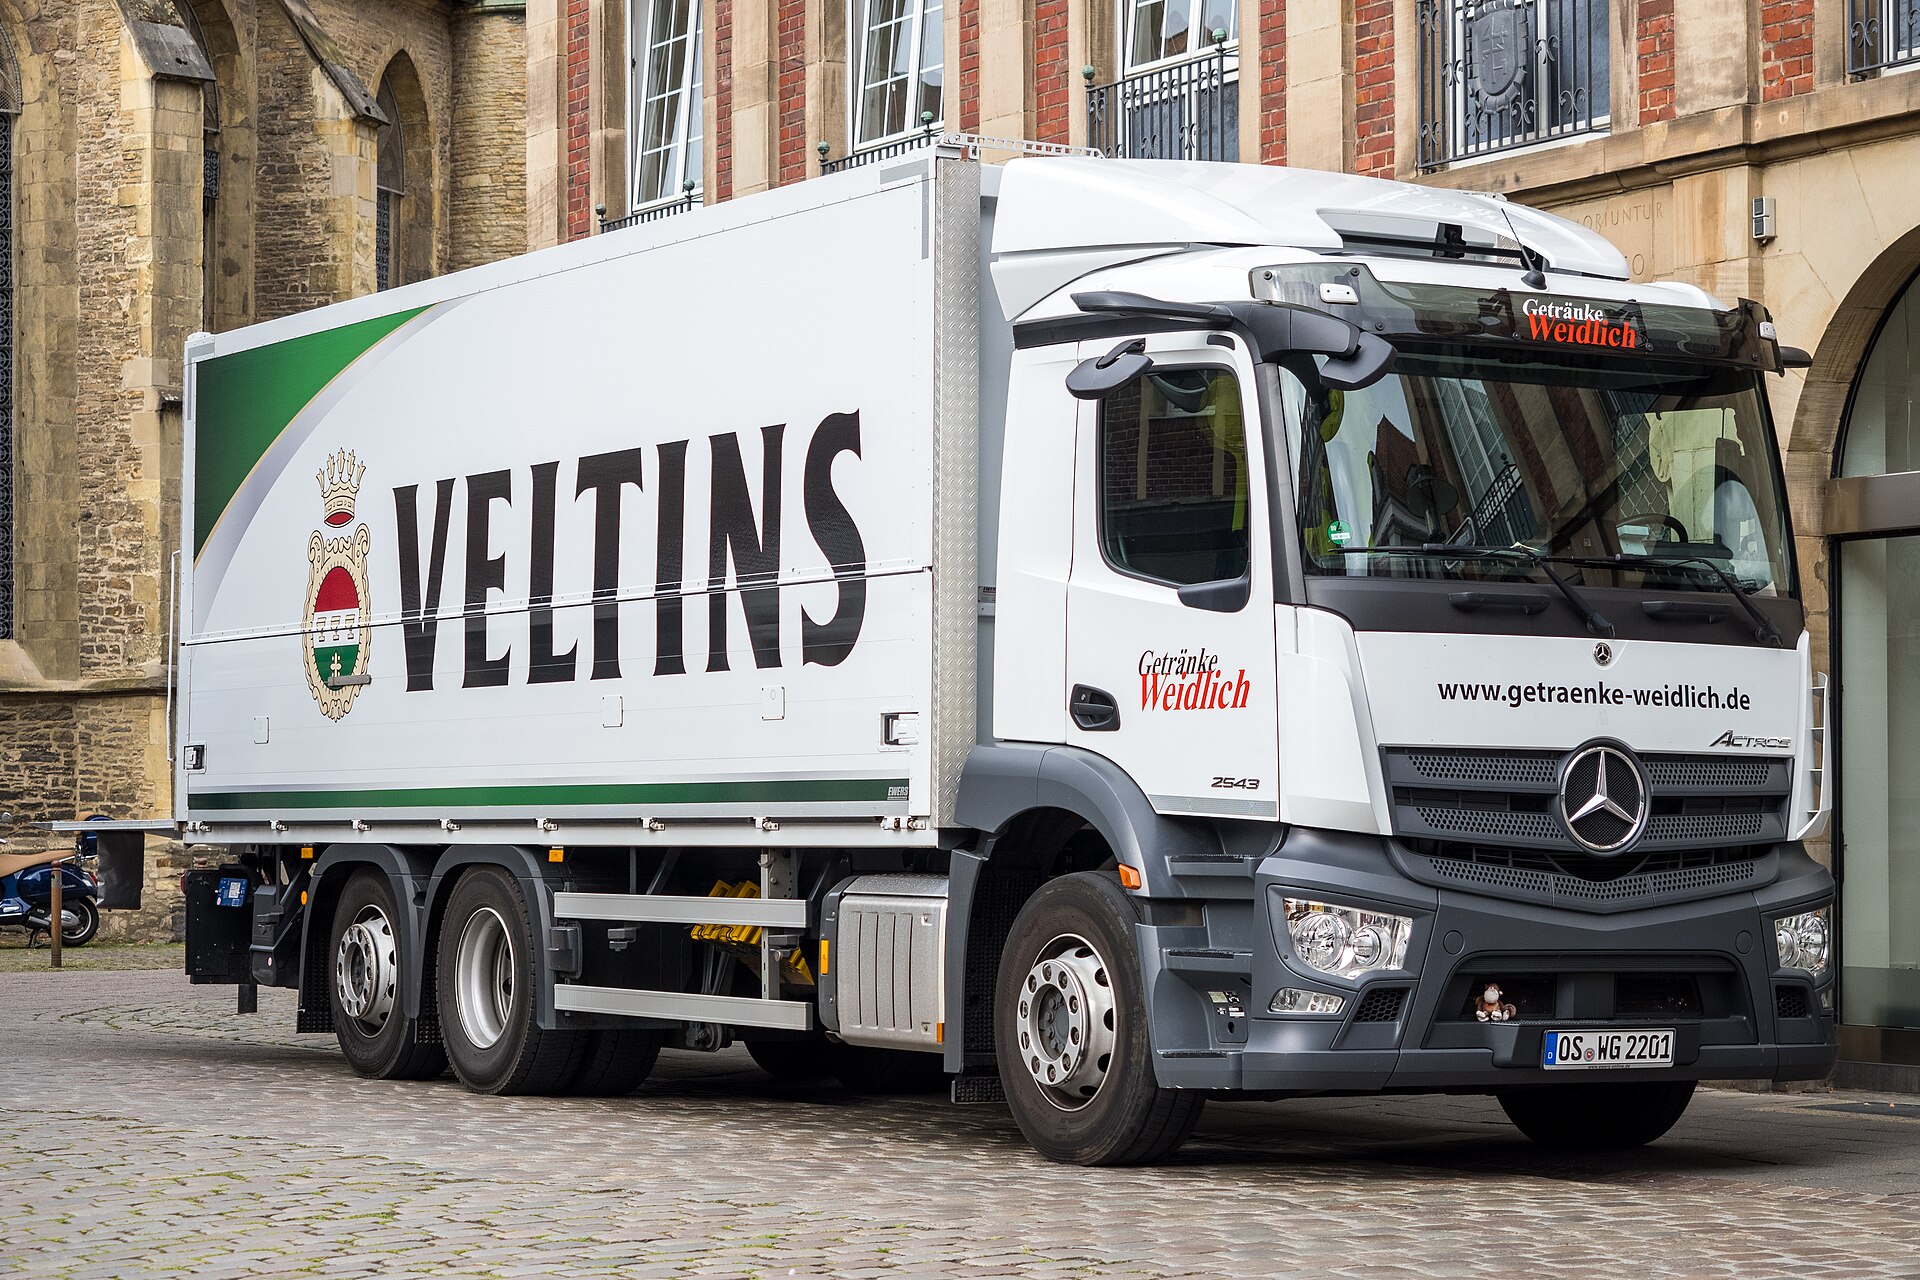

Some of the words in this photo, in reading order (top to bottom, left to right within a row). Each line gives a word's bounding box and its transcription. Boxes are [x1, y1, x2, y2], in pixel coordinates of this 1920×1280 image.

[1576, 201, 1664, 234] ORIUNTUR
[1522, 298, 1604, 322] Getränke
[1528, 313, 1636, 349] Weidlich
[392, 408, 867, 693] VELTINS
[1138, 647, 1218, 676] Getränke
[1141, 669, 1251, 712] Weidlich
[1437, 681, 1751, 710] www.getraenke-weidlich.de
[1210, 776, 1261, 790] 2543
[1558, 1035, 1584, 1061] OS
[1598, 1035, 1622, 1060] WG
[1625, 1034, 1670, 1060] 2201
